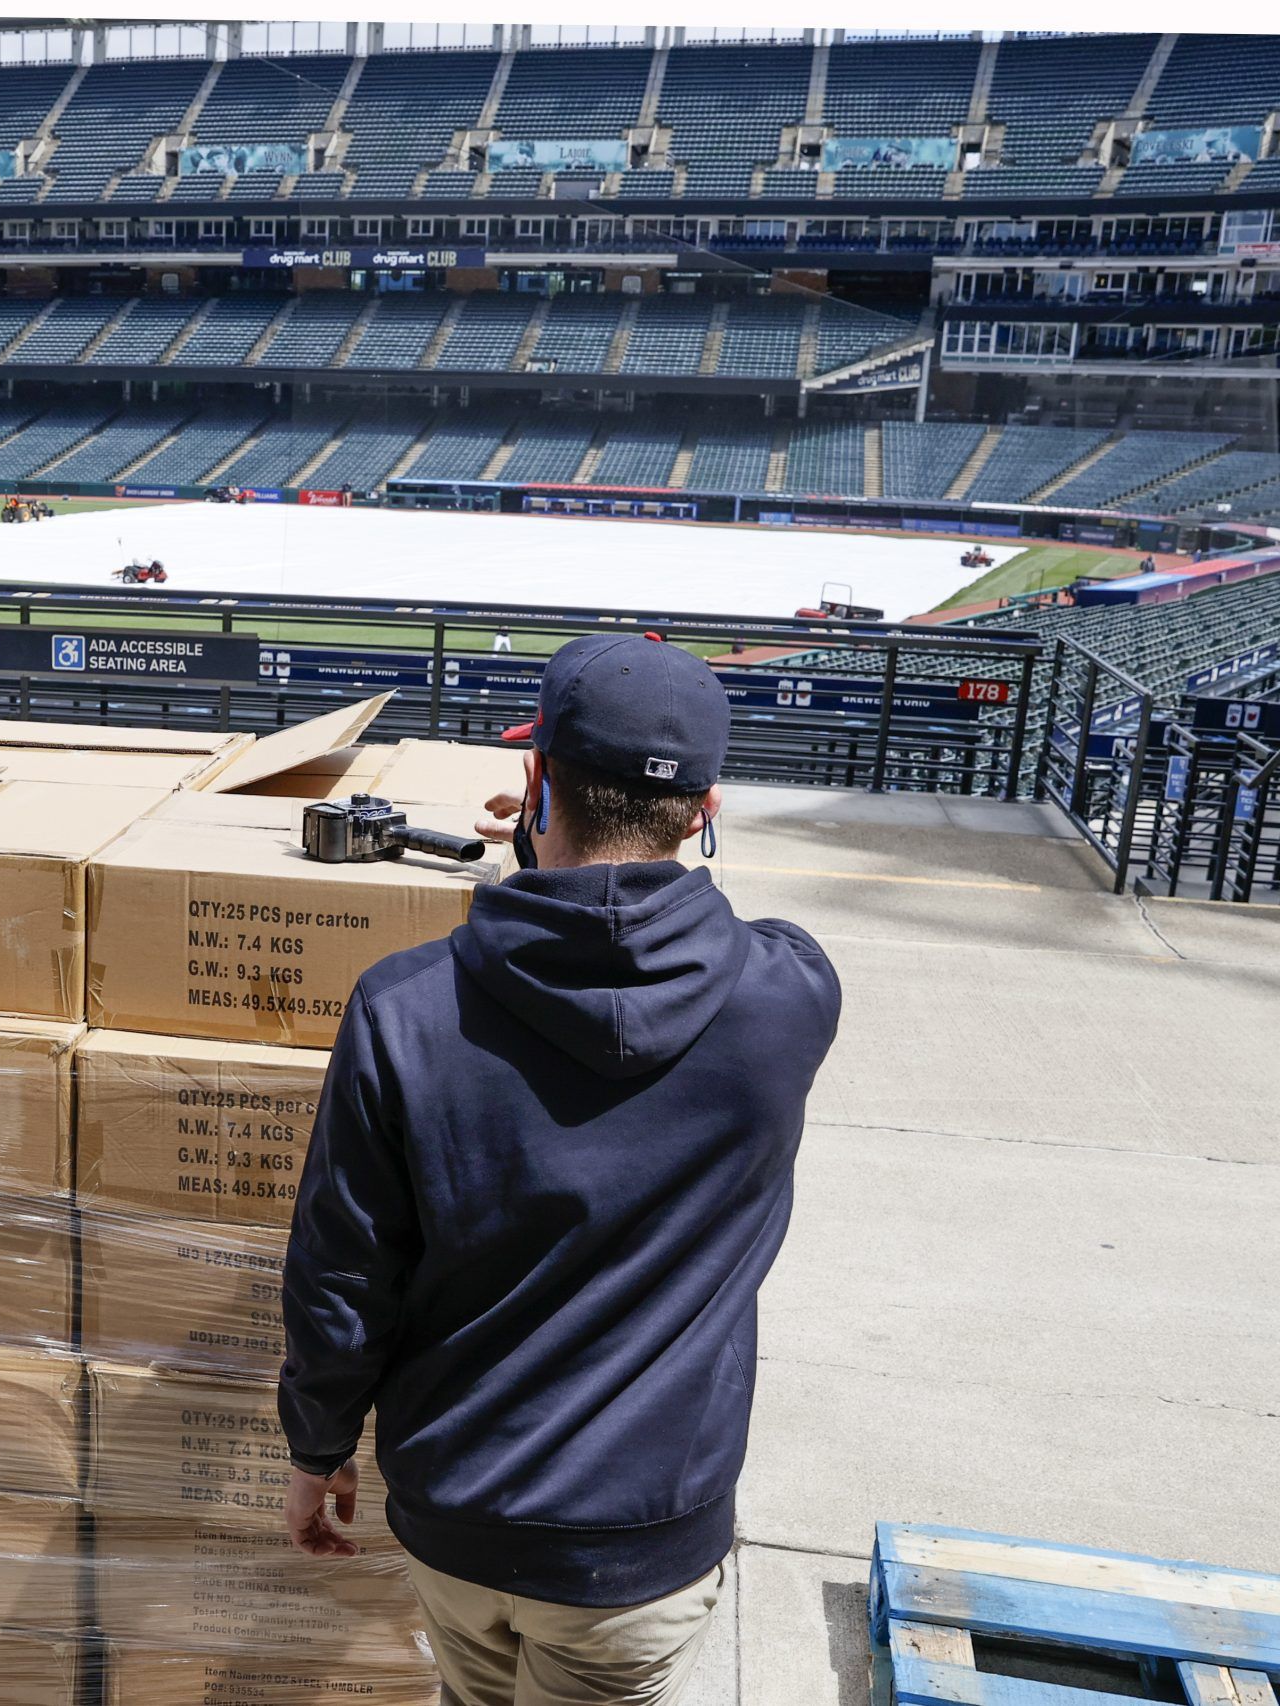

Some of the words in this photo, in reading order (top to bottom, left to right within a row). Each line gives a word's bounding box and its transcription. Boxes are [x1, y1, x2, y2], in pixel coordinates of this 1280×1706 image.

[264, 150, 293, 163] WYNN
[269, 254, 293, 266] drug
[294, 254, 320, 264] mart
[322, 250, 351, 266] CLUB
[373, 254, 397, 266] drug
[398, 254, 424, 264] mart
[427, 251, 457, 266] CLUB
[898, 364, 920, 382] CLUB
[89, 640, 118, 654] ADA
[120, 641, 204, 658] ACCESSIBLE
[89, 656, 144, 672] SEATING
[147, 658, 187, 673] AREA
[968, 684, 1000, 700] 178
[188, 900, 245, 920] QTY:25
[250, 906, 281, 923] PCS
[285, 910, 312, 928] per
[316, 912, 370, 930] carton
[188, 930, 229, 949] N.W.:
[237, 934, 261, 952] 7.4
[270, 937, 304, 955] KGS
[188, 960, 228, 979] G.W.:
[236, 964, 261, 982] 9.3
[270, 966, 303, 985] KGS
[188, 989, 238, 1008] MEAS:
[242, 994, 348, 1018] 49.5X49.5X2
[178, 1088, 236, 1109] QTY:25
[240, 1093, 271, 1111] PCS
[276, 1097, 304, 1116] per
[178, 1118, 218, 1136] N.W.:
[227, 1122, 252, 1140] 7.4
[260, 1124, 294, 1142] KGS
[178, 1147, 218, 1164] G.W.:
[227, 1151, 252, 1168] 9.3
[260, 1153, 294, 1171] KGS
[178, 1176, 228, 1194] MEAS:
[232, 1180, 296, 1200] 49.5X49
[178, 1246, 200, 1260] cm
[189, 1330, 240, 1348] carton
[242, 1336, 269, 1352] per
[181, 1410, 236, 1429] QTY:25
[240, 1416, 270, 1432] PCS
[228, 1440, 251, 1458] 7.4
[259, 1444, 291, 1461] KGS
[194, 1530, 217, 1541] Item
[238, 1582, 270, 1594] CHINA
[204, 1666, 227, 1678] Item
[274, 1674, 288, 1686] OZ
[325, 1680, 374, 1696] TUMBLER
